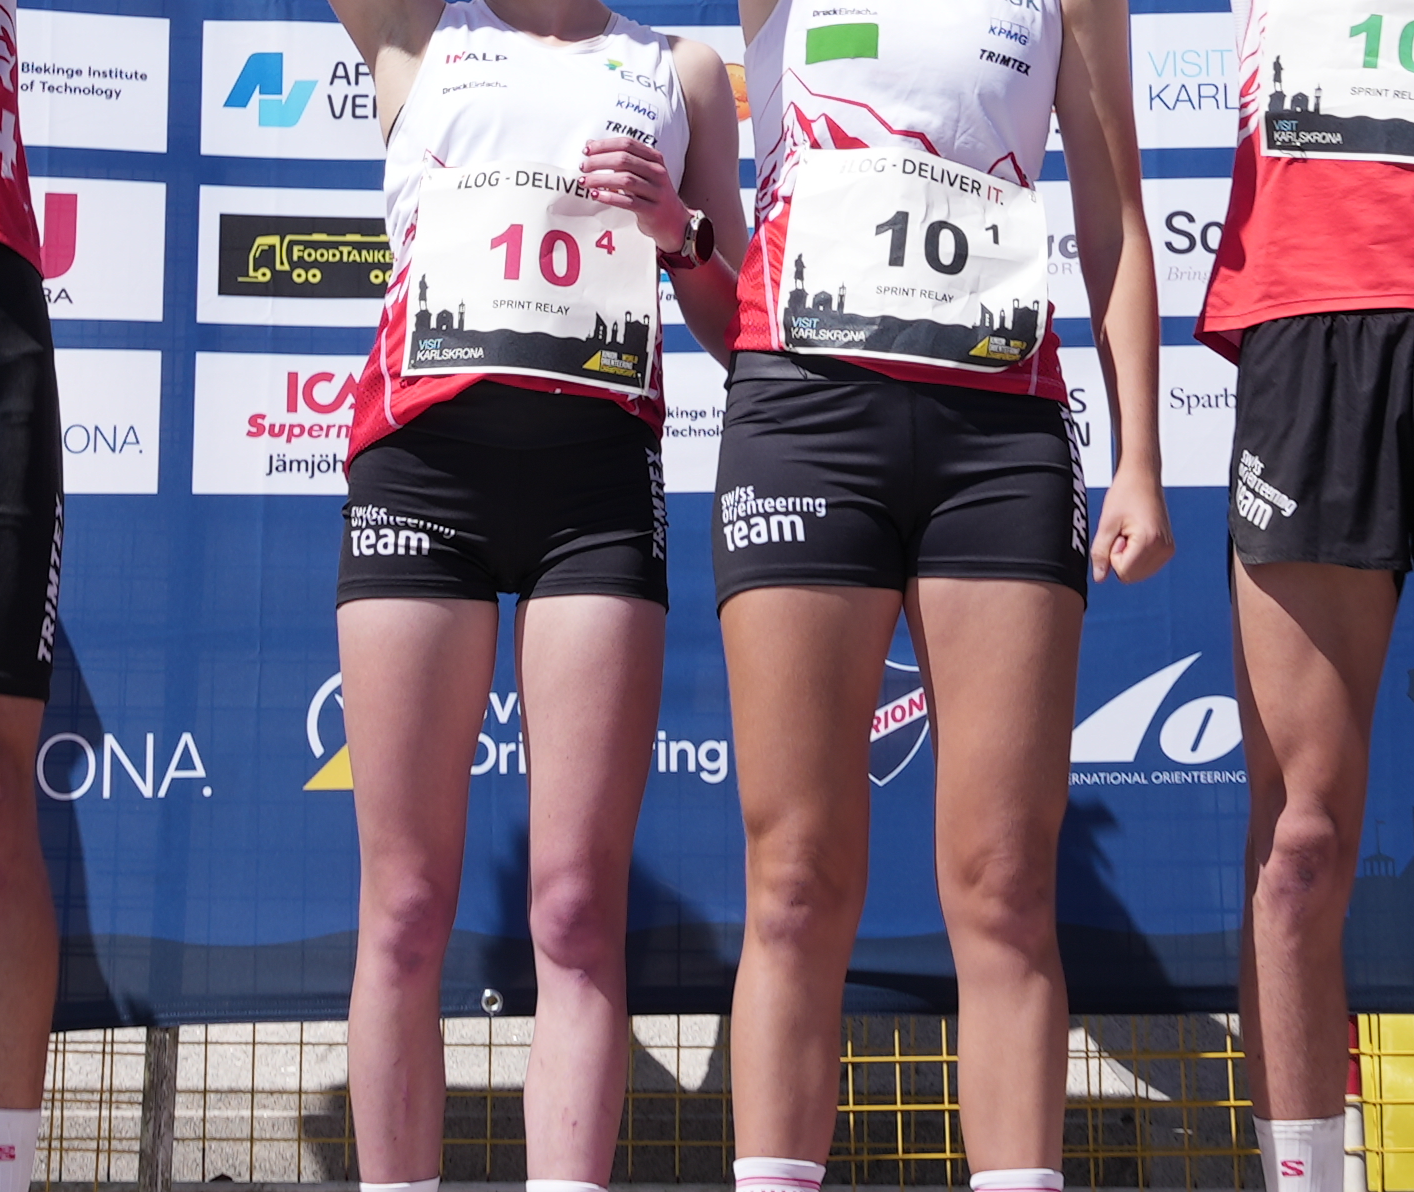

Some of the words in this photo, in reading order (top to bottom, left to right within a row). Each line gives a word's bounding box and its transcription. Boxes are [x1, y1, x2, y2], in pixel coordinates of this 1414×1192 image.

[988, 24, 1028, 46] KPMG
[20, 61, 84, 79] Blekinge
[88, 65, 149, 83] Institute
[979, 48, 1032, 76] TRIMTEX
[1147, 49, 1233, 78] VISIT
[20, 79, 34, 94] of
[38, 80, 123, 101] Technology
[619, 69, 669, 98] EGK
[1350, 86, 1390, 99] SPRINT
[615, 99, 658, 121] KPMG
[605, 120, 659, 148] TRIMTEX
[1273, 120, 1299, 131] VISIT
[902, 158, 982, 198] DELIVER
[987, 183, 1005, 206] IT.
[874, 210, 969, 276] 10
[984, 223, 1001, 246] 1
[489, 223, 582, 288] 10
[595, 229, 616, 255] 4
[875, 284, 916, 299] SPRINT
[919, 288, 955, 304] RELAY
[492, 299, 532, 313] SPRINT
[535, 302, 571, 316] RELAY
[791, 316, 820, 330] VISIT
[419, 338, 444, 350] VISIT
[790, 326, 866, 343] KARLSKRONA
[416, 347, 485, 362] KARLSKRONA
[721, 496, 827, 524] orienteering
[350, 527, 431, 557] team
[723, 514, 806, 553] team
[36, 492, 64, 664] TRIMTEX
[1150, 770, 1247, 785] ORIENTEERING
